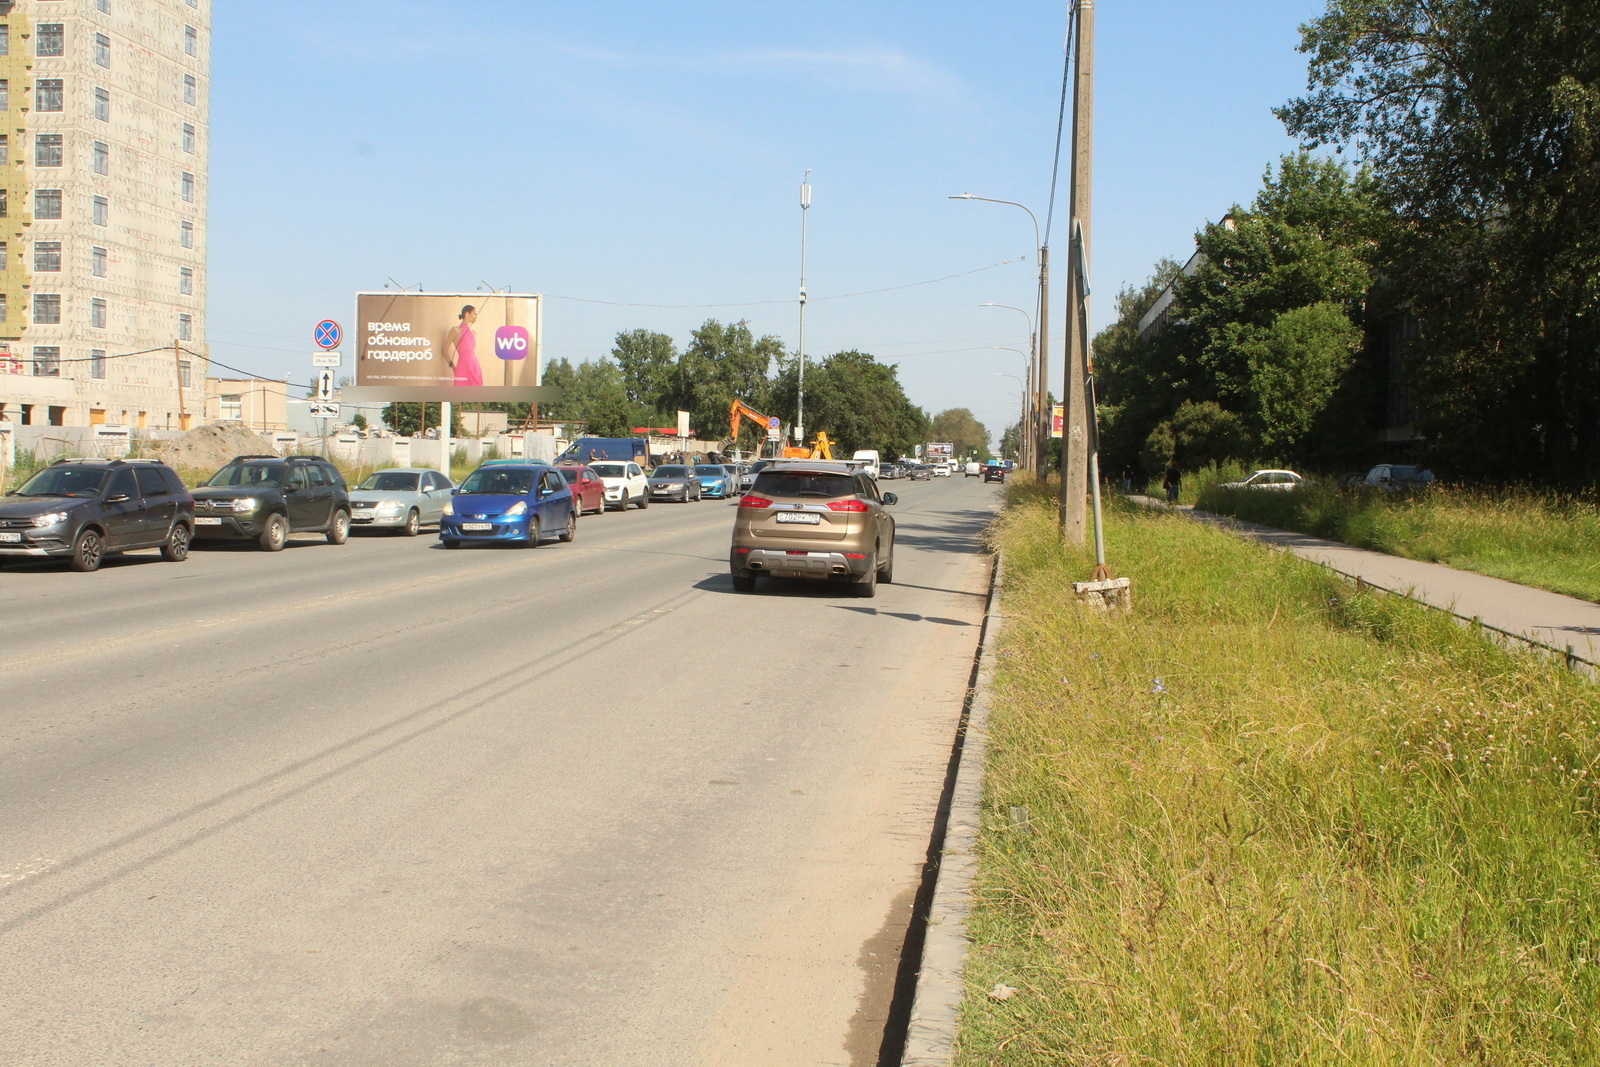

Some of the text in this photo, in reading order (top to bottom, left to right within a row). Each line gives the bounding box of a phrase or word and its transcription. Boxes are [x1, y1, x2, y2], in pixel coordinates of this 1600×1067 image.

[367, 322, 410, 334] время
[367, 333, 431, 346] обновить
[497, 332, 527, 351] wb
[367, 348, 433, 363] гардероб
